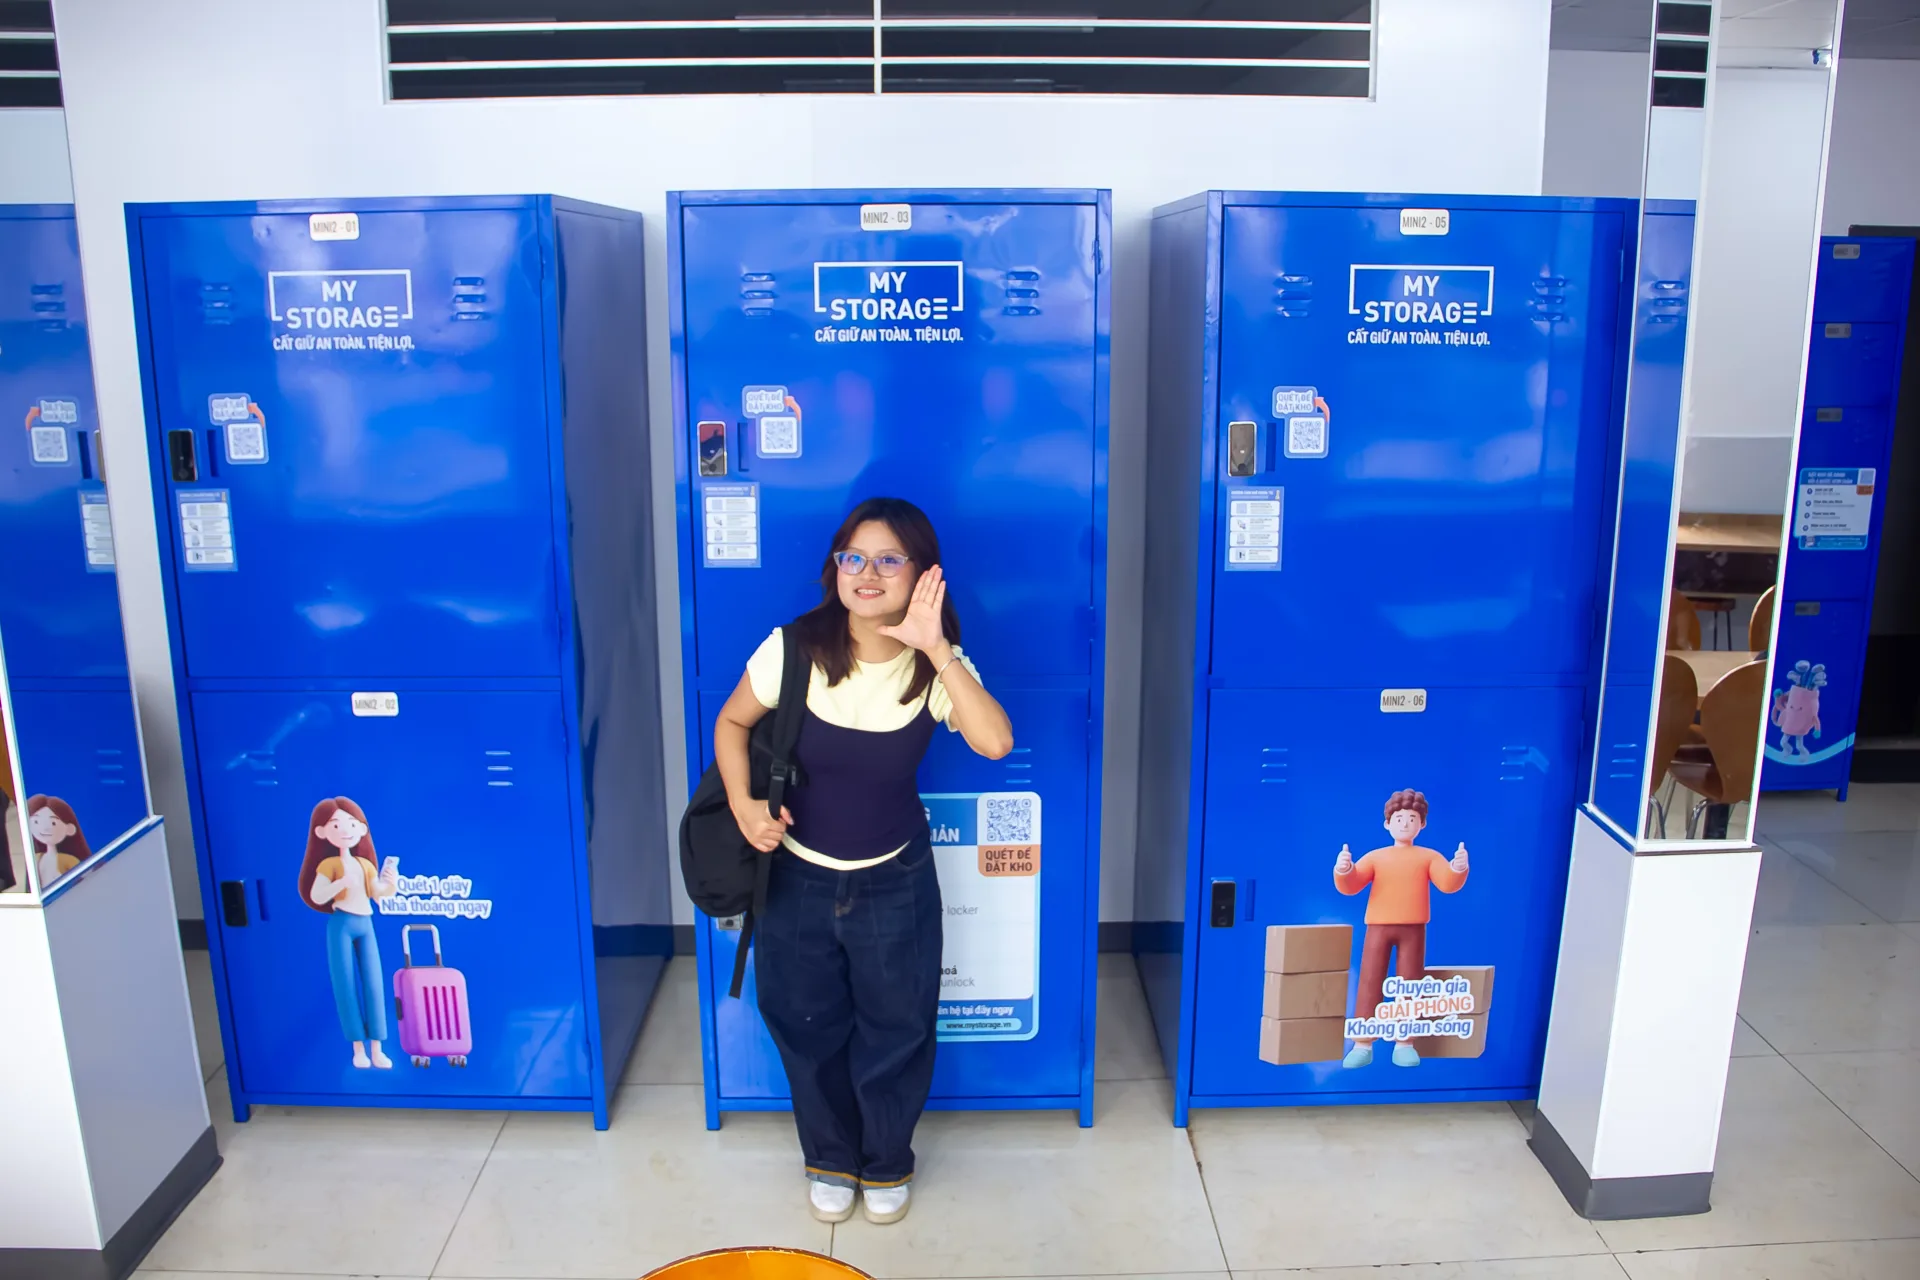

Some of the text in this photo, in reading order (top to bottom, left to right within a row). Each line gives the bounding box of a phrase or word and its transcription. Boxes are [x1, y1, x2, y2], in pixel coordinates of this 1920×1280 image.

[313, 221, 337, 234] MINI2
[345, 220, 356, 233] 01
[863, 212, 888, 224] MINI2
[897, 211, 909, 223] 03
[1402, 216, 1427, 229] MINI2
[1435, 216, 1447, 229] 05
[321, 280, 357, 302] MY
[869, 271, 907, 294] MY
[1403, 275, 1440, 297] MY
[286, 306, 399, 329] STORAGE
[830, 297, 948, 321] STORAGE
[1364, 301, 1478, 324] STORAGE
[273, 333, 293, 350] CẤT
[295, 334, 316, 350] GIỮ
[316, 336, 332, 350] AN
[333, 334, 366, 350] TOÀN.
[367, 333, 394, 352] TIỆN
[814, 325, 964, 344] CẤT GIỮ AN TOÀN. TIỆN LỢI.
[1347, 327, 1490, 347] CẤT GIỮ AN TOÀN. TIỆN LỢI.
[1295, 403, 1312, 411] KHO
[1382, 695, 1405, 706] MINI2
[1413, 694, 1424, 706] 06
[930, 823, 959, 843] IẢN
[985, 848, 1014, 861] QUÉT
[985, 860, 1033, 874] ĐẶT KHO
[397, 876, 469, 896] Quét 1 giây
[382, 896, 407, 911] Nhà
[458, 902, 489, 917] ngay
[947, 904, 979, 915] locker
[1385, 978, 1467, 998] Chuyên gia
[1378, 995, 1471, 1020] GIẢI PHÓNG
[946, 1021, 1012, 1030] www.mystorage.vn
[1347, 1016, 1471, 1038] Không gian sống
